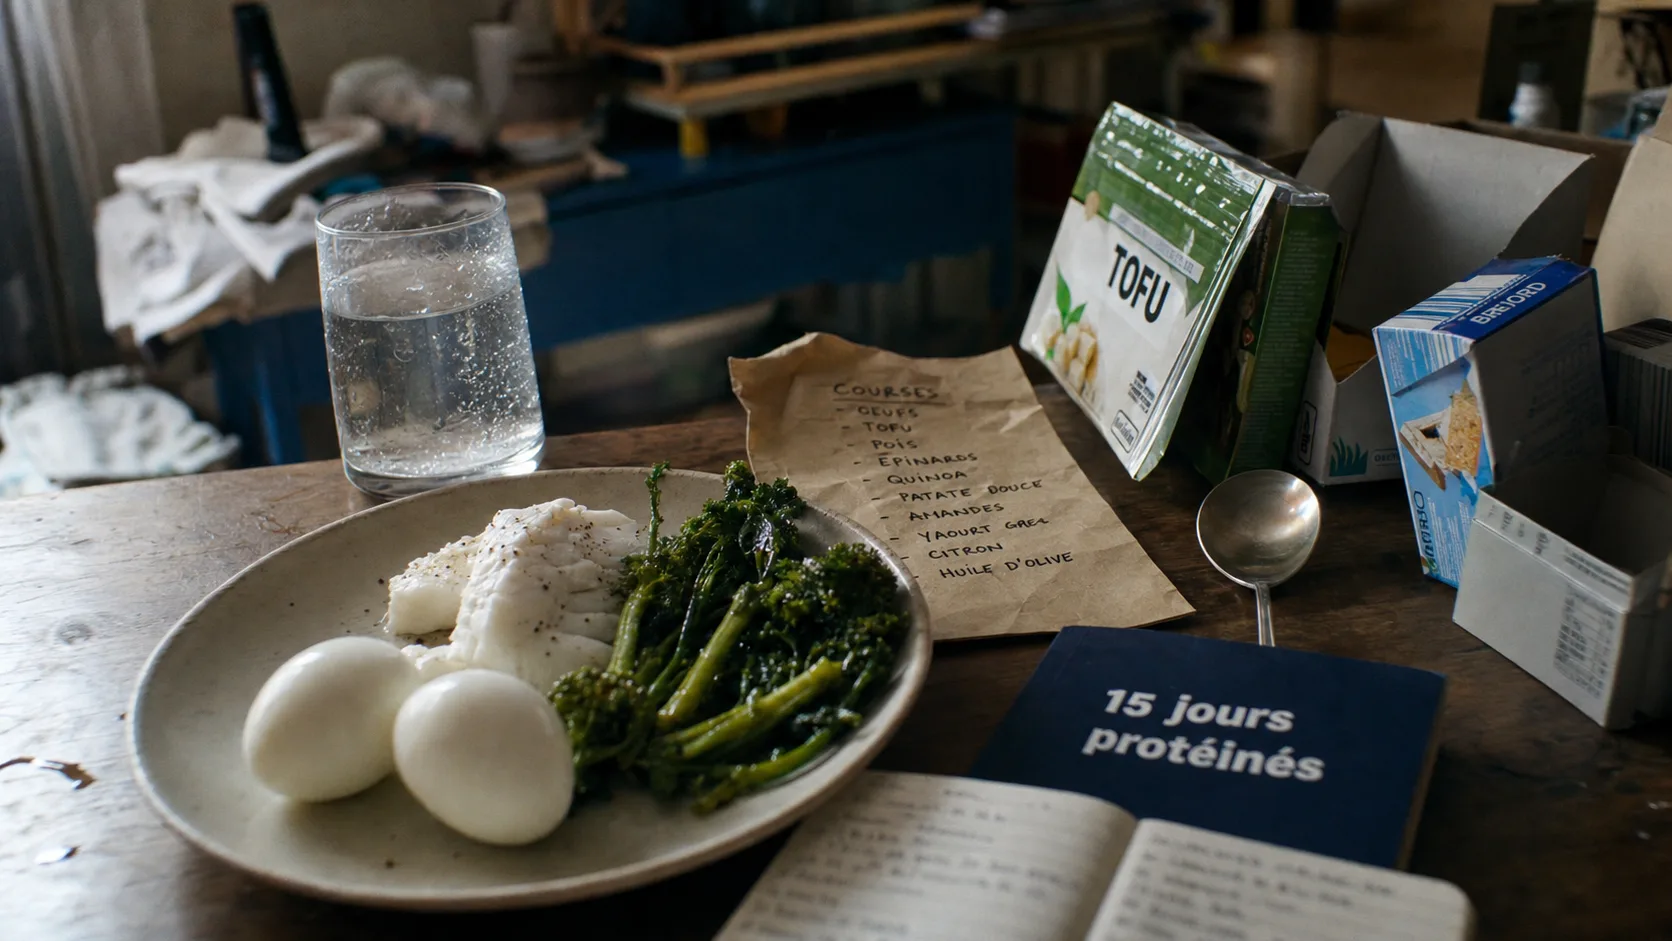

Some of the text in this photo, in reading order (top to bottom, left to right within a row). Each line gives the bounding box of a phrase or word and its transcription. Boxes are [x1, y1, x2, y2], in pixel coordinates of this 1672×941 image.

[1107, 243, 1171, 324] TOFU
[833, 383, 939, 399] COURSES
[857, 406, 919, 418] OEUFS
[862, 421, 912, 432] TOFU
[899, 479, 1042, 502] PATATE DOUCE
[909, 503, 1005, 521] AMANDES
[918, 524, 991, 543] YAOURT
[928, 543, 1004, 560] CITRON
[1004, 552, 1074, 571] D'OLIVE
[1104, 689, 1295, 732] 15 jours
[1081, 727, 1326, 782] protéinés
